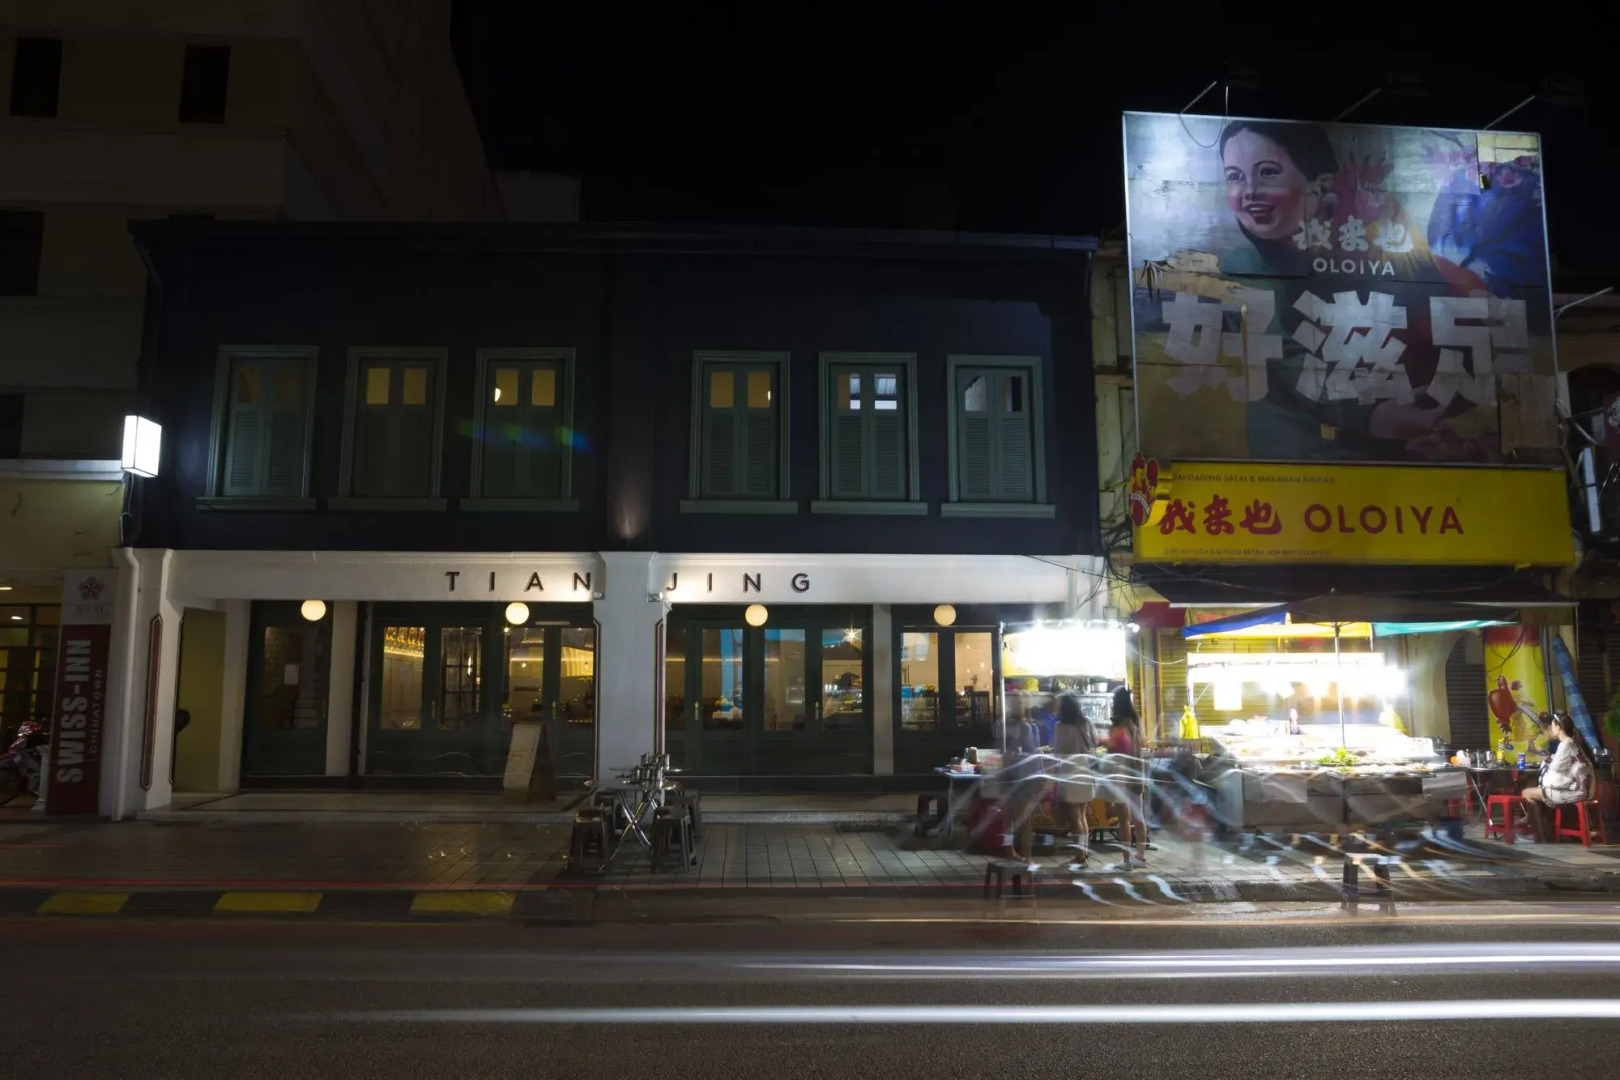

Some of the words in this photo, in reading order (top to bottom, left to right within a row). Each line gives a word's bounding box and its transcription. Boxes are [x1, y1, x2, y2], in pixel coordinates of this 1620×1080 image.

[1312, 257, 1396, 276] OLOIYA
[1304, 504, 1464, 534] OLOIYA
[445, 571, 592, 592] TIAN
[665, 571, 811, 593] JING
[56, 639, 92, 783] SWISS-INN
[90, 669, 103, 754] CHINATOWN
